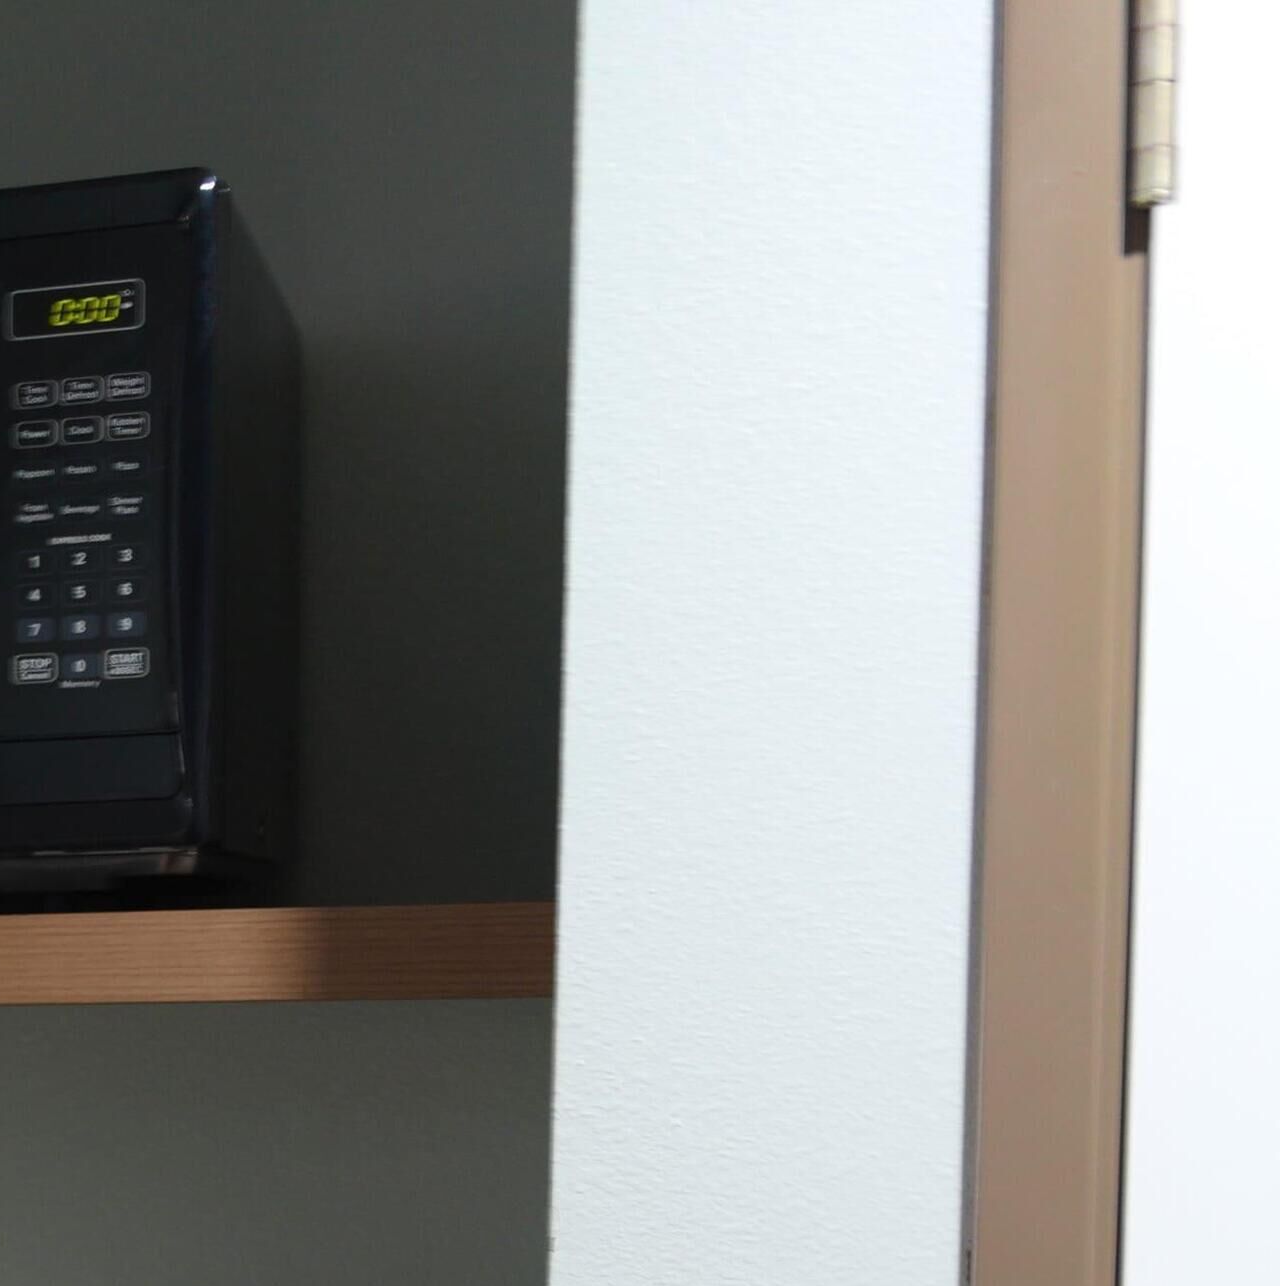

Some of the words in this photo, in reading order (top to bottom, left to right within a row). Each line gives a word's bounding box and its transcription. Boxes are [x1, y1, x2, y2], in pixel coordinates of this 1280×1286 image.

[48, 294, 122, 327] 0:00
[28, 555, 40, 568] 1
[70, 552, 87, 566] 2
[117, 548, 133, 562] 3
[26, 588, 42, 601] 4
[71, 585, 87, 599] 5
[117, 582, 133, 596] 6
[27, 623, 42, 637] 7
[71, 619, 87, 634] 8
[117, 617, 133, 631] 9
[72, 659, 87, 673] 0
